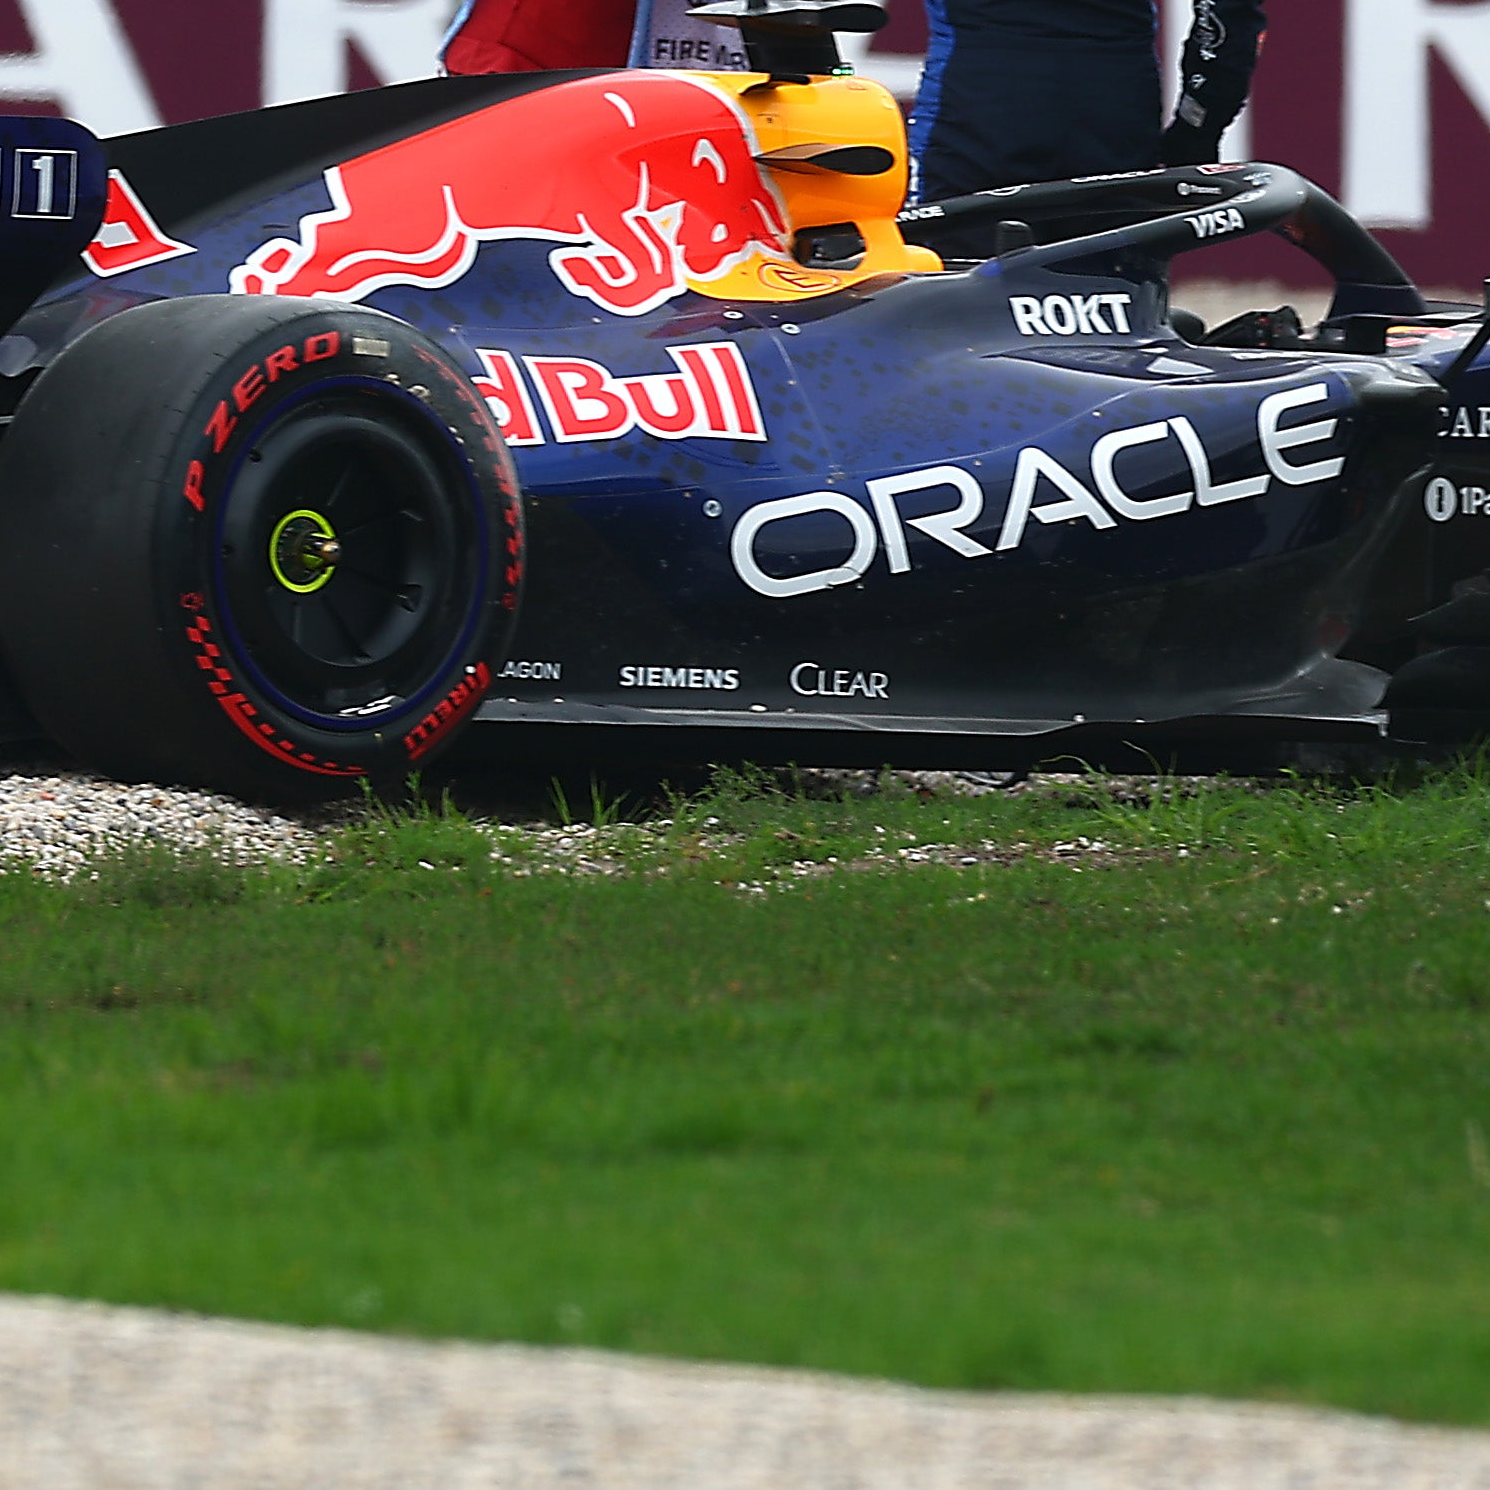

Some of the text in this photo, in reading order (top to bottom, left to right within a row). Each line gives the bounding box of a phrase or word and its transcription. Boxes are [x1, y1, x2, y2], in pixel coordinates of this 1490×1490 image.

[656, 38, 711, 62] FIRE
[1183, 208, 1246, 239] VISA
[1009, 293, 1132, 336] ROKT
[521, 341, 768, 443] Bull
[183, 330, 342, 512] P ZERO
[729, 382, 1347, 598] ORACLE
[498, 661, 562, 681] AGON
[619, 665, 741, 691] SIEMENS
[790, 661, 890, 699] CLEAR
